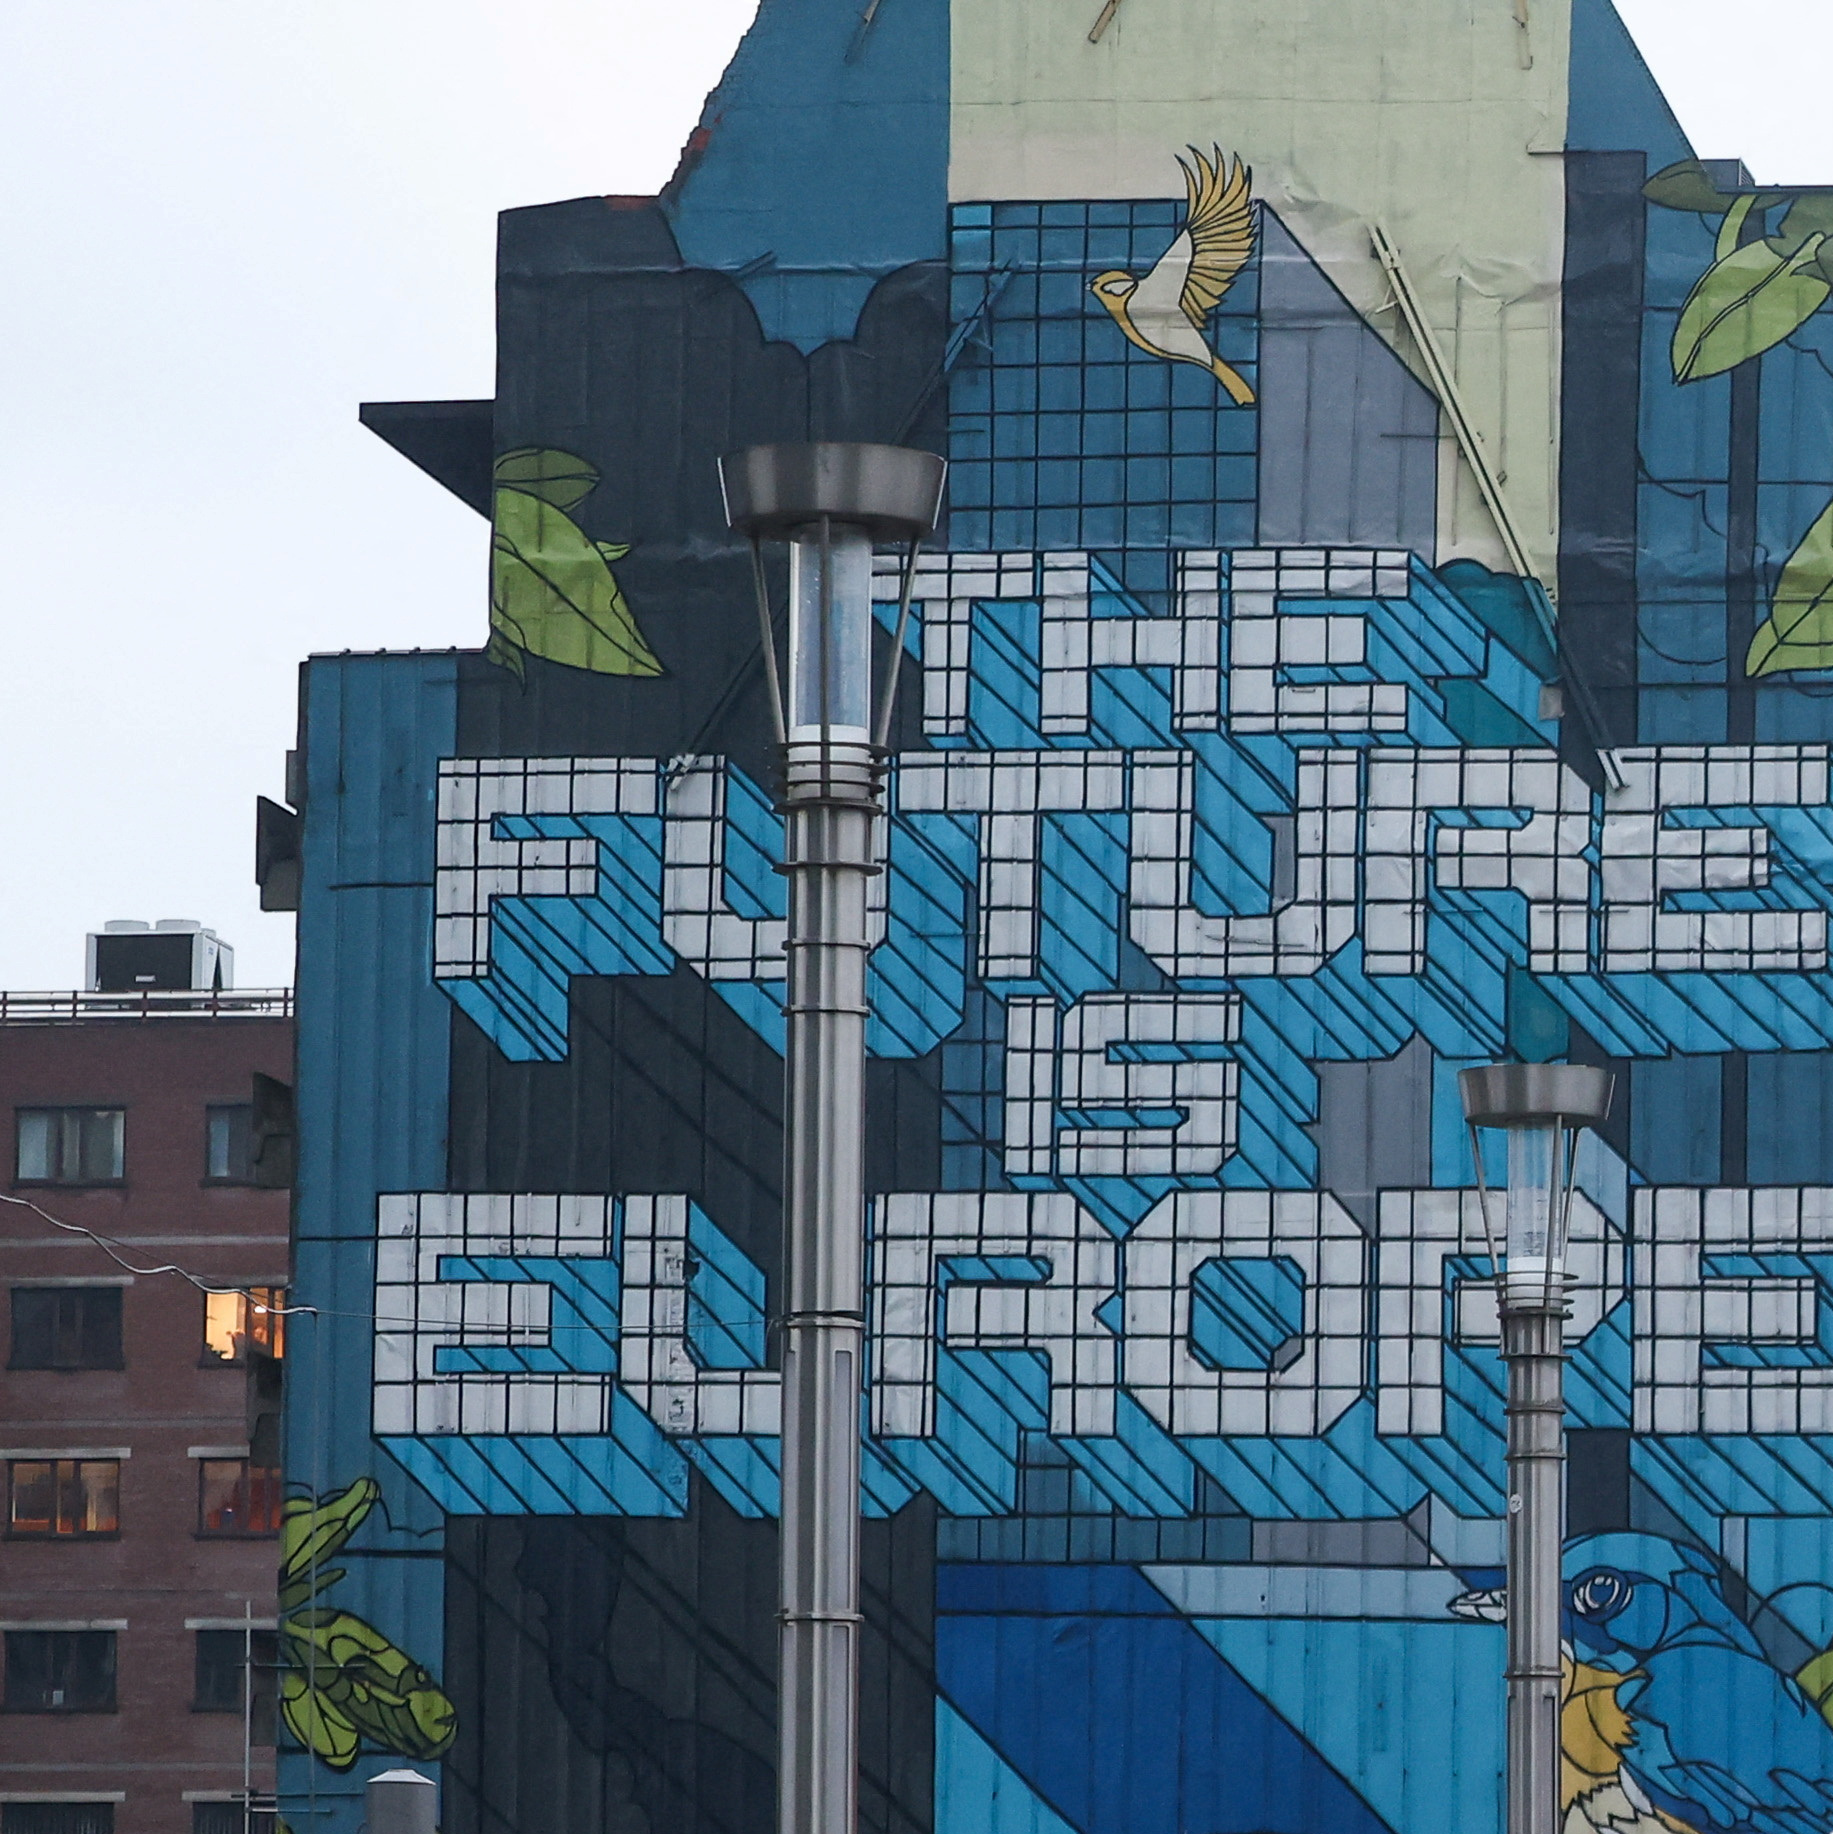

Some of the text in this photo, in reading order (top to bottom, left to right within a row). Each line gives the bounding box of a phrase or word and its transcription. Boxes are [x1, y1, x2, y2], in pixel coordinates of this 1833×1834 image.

[872, 551, 1410, 734] THE
[437, 744, 1830, 980] FUTURE
[1007, 993, 1242, 1178] IS
